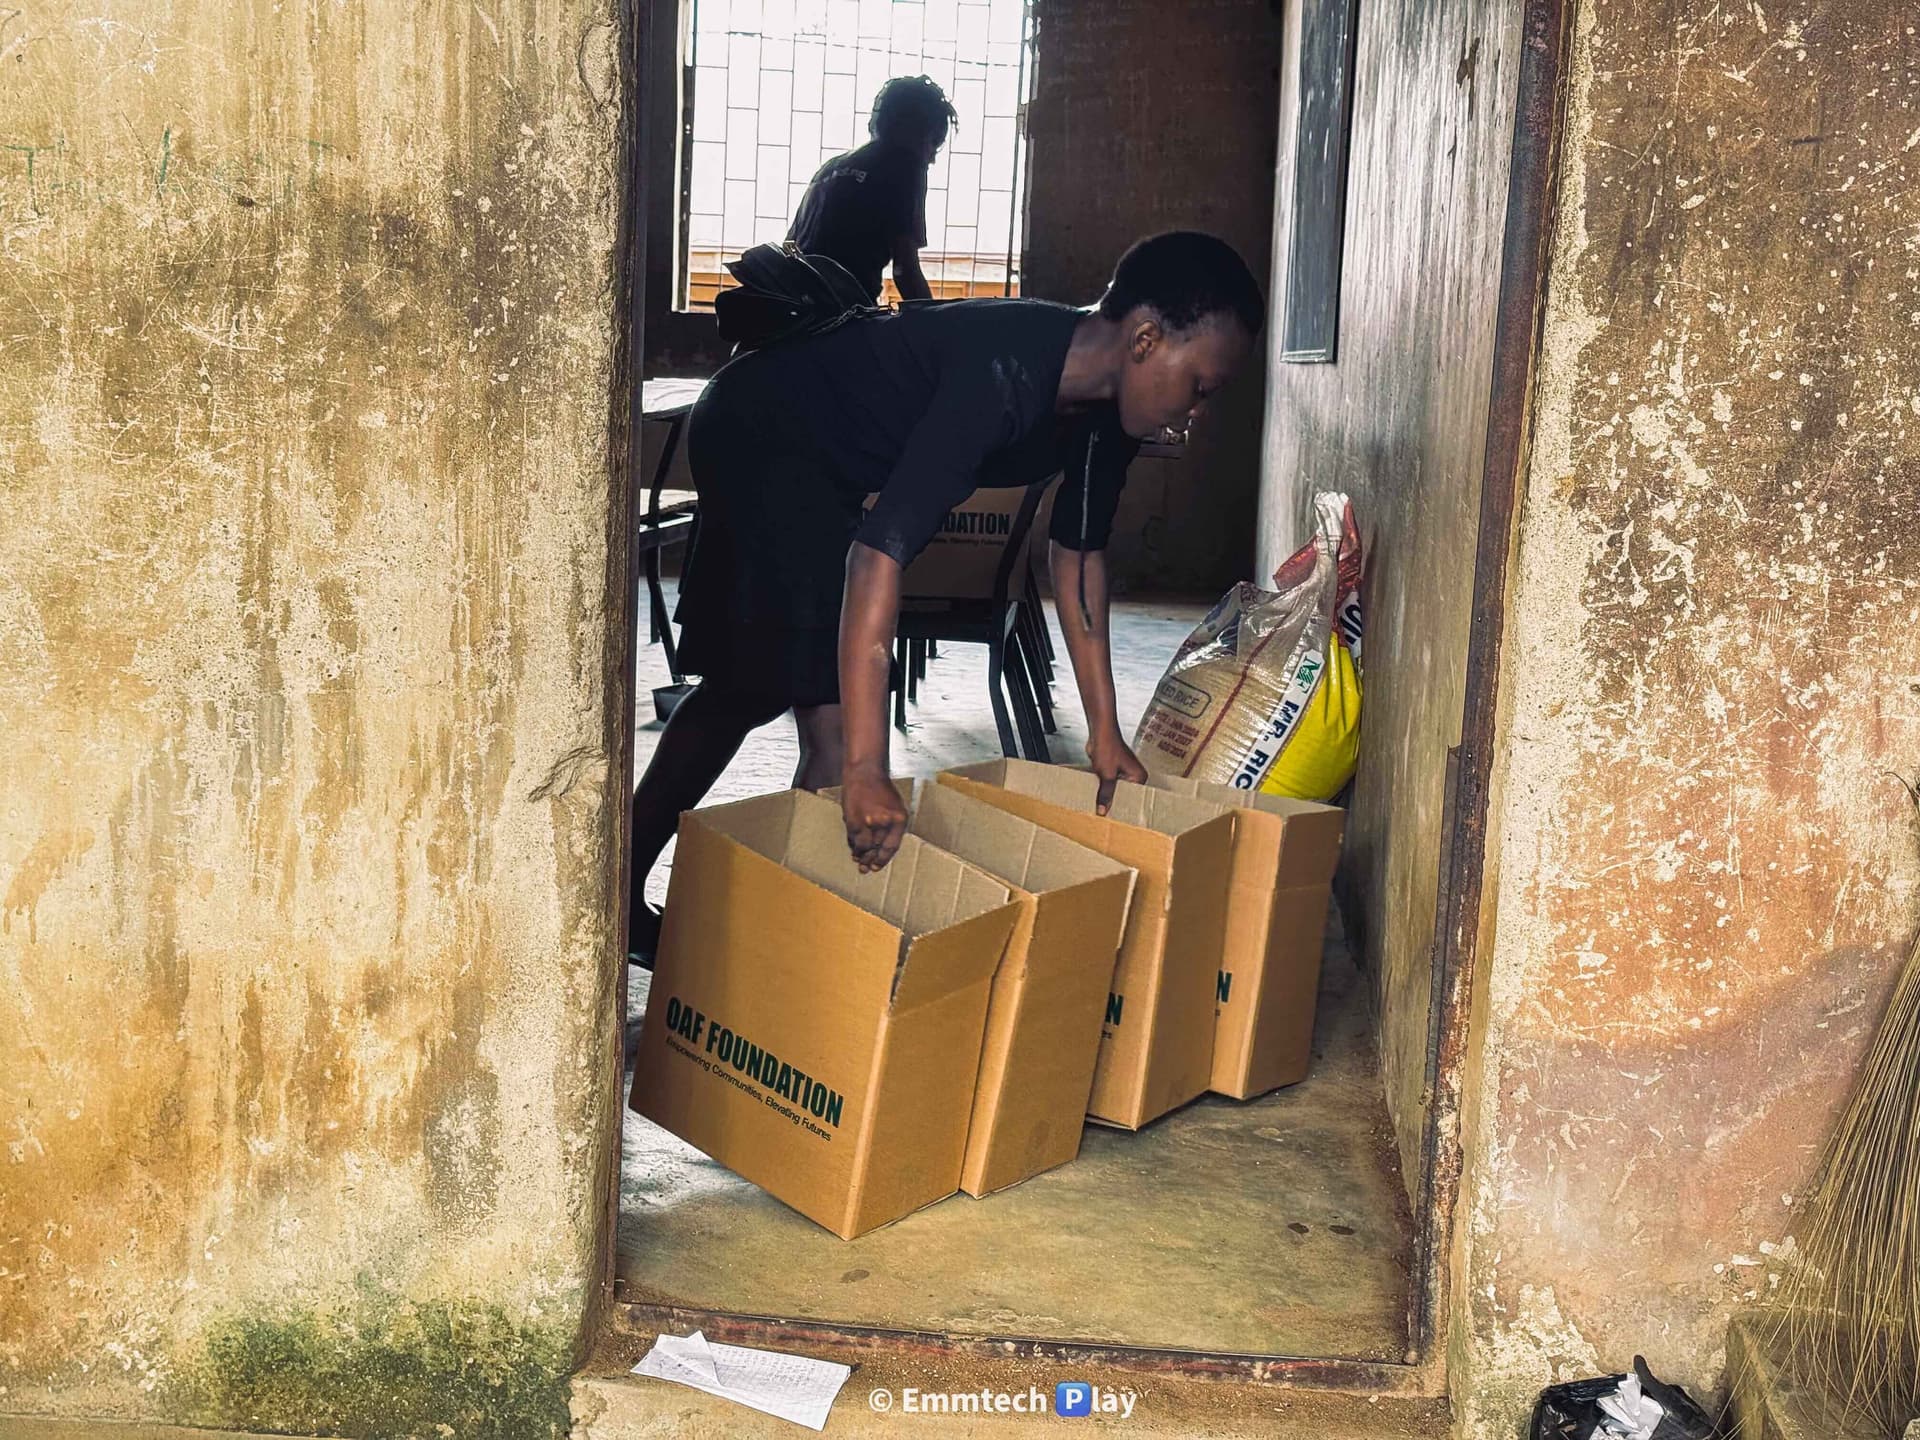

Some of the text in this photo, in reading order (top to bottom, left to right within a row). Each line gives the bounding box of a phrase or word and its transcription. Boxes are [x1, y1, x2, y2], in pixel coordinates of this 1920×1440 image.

[942, 512, 1010, 535] DATION
[1235, 749, 1269, 790] RIC
[666, 997, 844, 1128] OAF FOUNDATION
[666, 1035, 832, 1141] Empowering Communities, Elevating Futures
